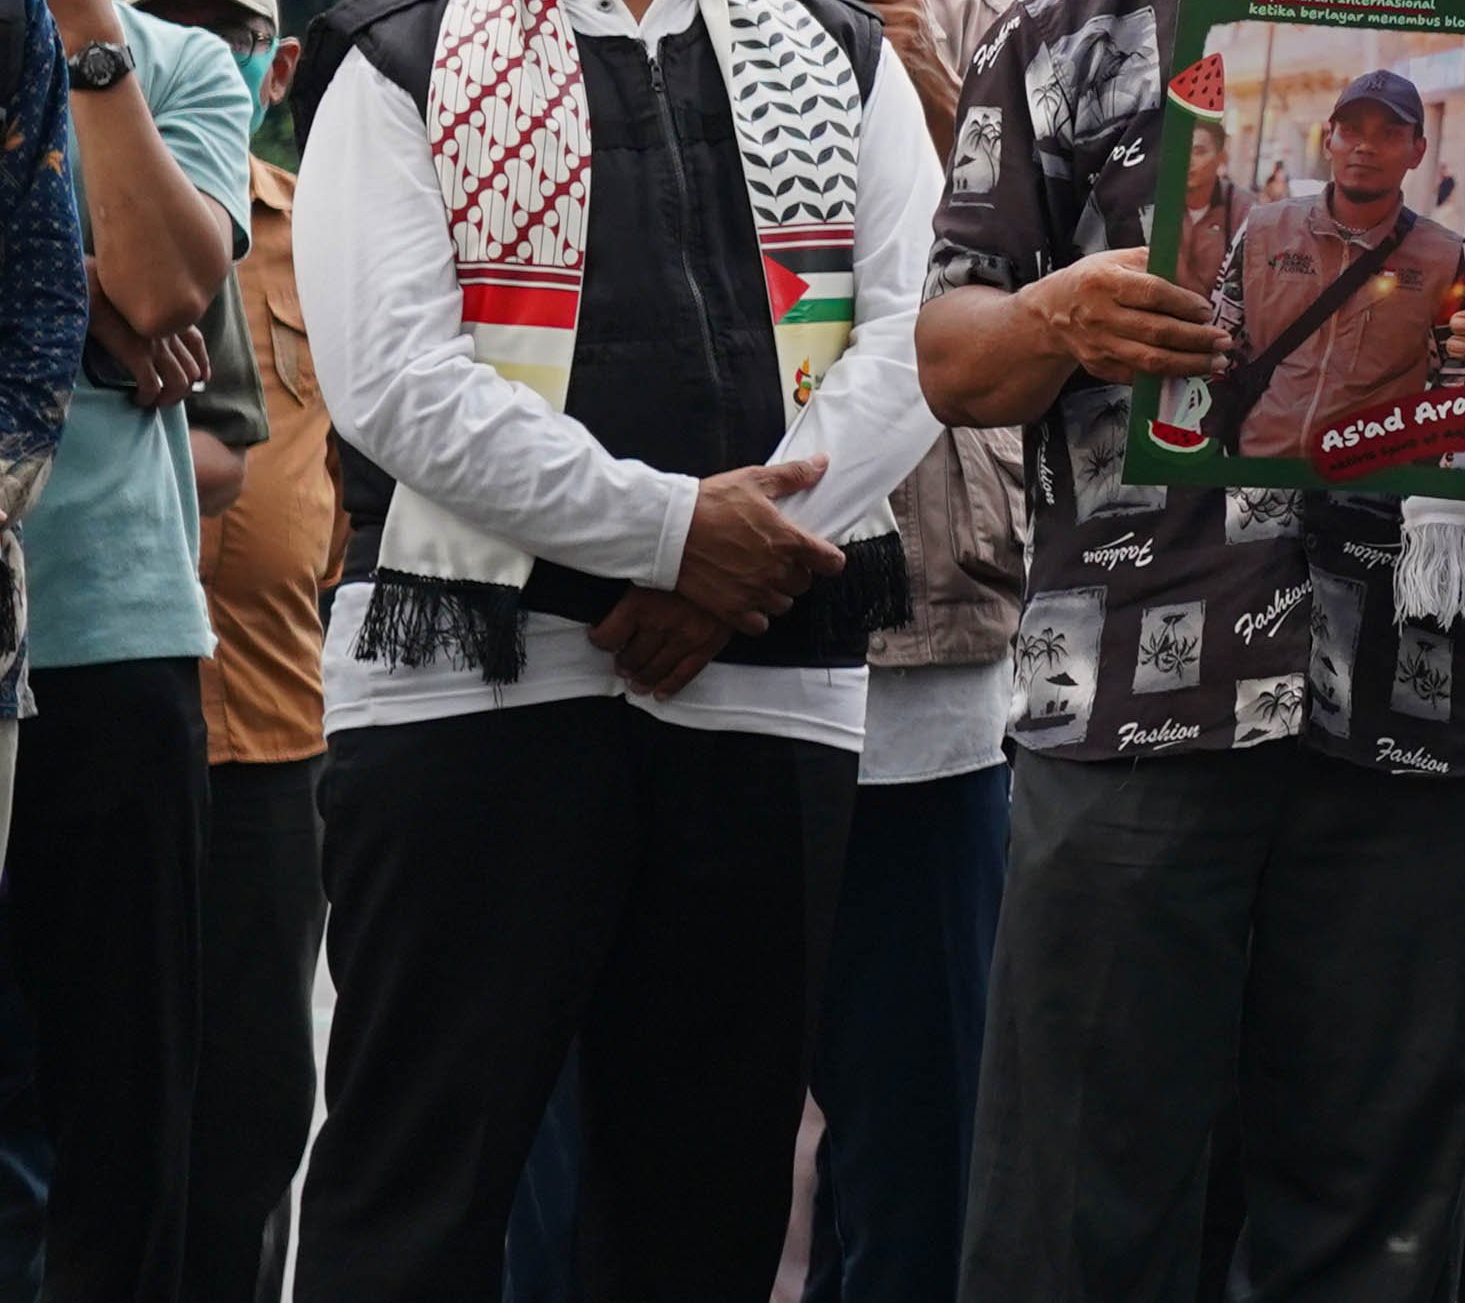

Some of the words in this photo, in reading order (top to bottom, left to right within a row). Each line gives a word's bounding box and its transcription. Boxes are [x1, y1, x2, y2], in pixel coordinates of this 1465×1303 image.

[1249, 2, 1296, 18] ketika
[1300, 7, 1364, 25] berlayar
[1367, 12, 1441, 28] menembus
[1321, 407, 1405, 452] As'ad
[1083, 537, 1154, 571] Fashion
[1234, 578, 1313, 645] Fashion
[1118, 718, 1200, 751] Fashion
[1376, 737, 1449, 774] Fashion
